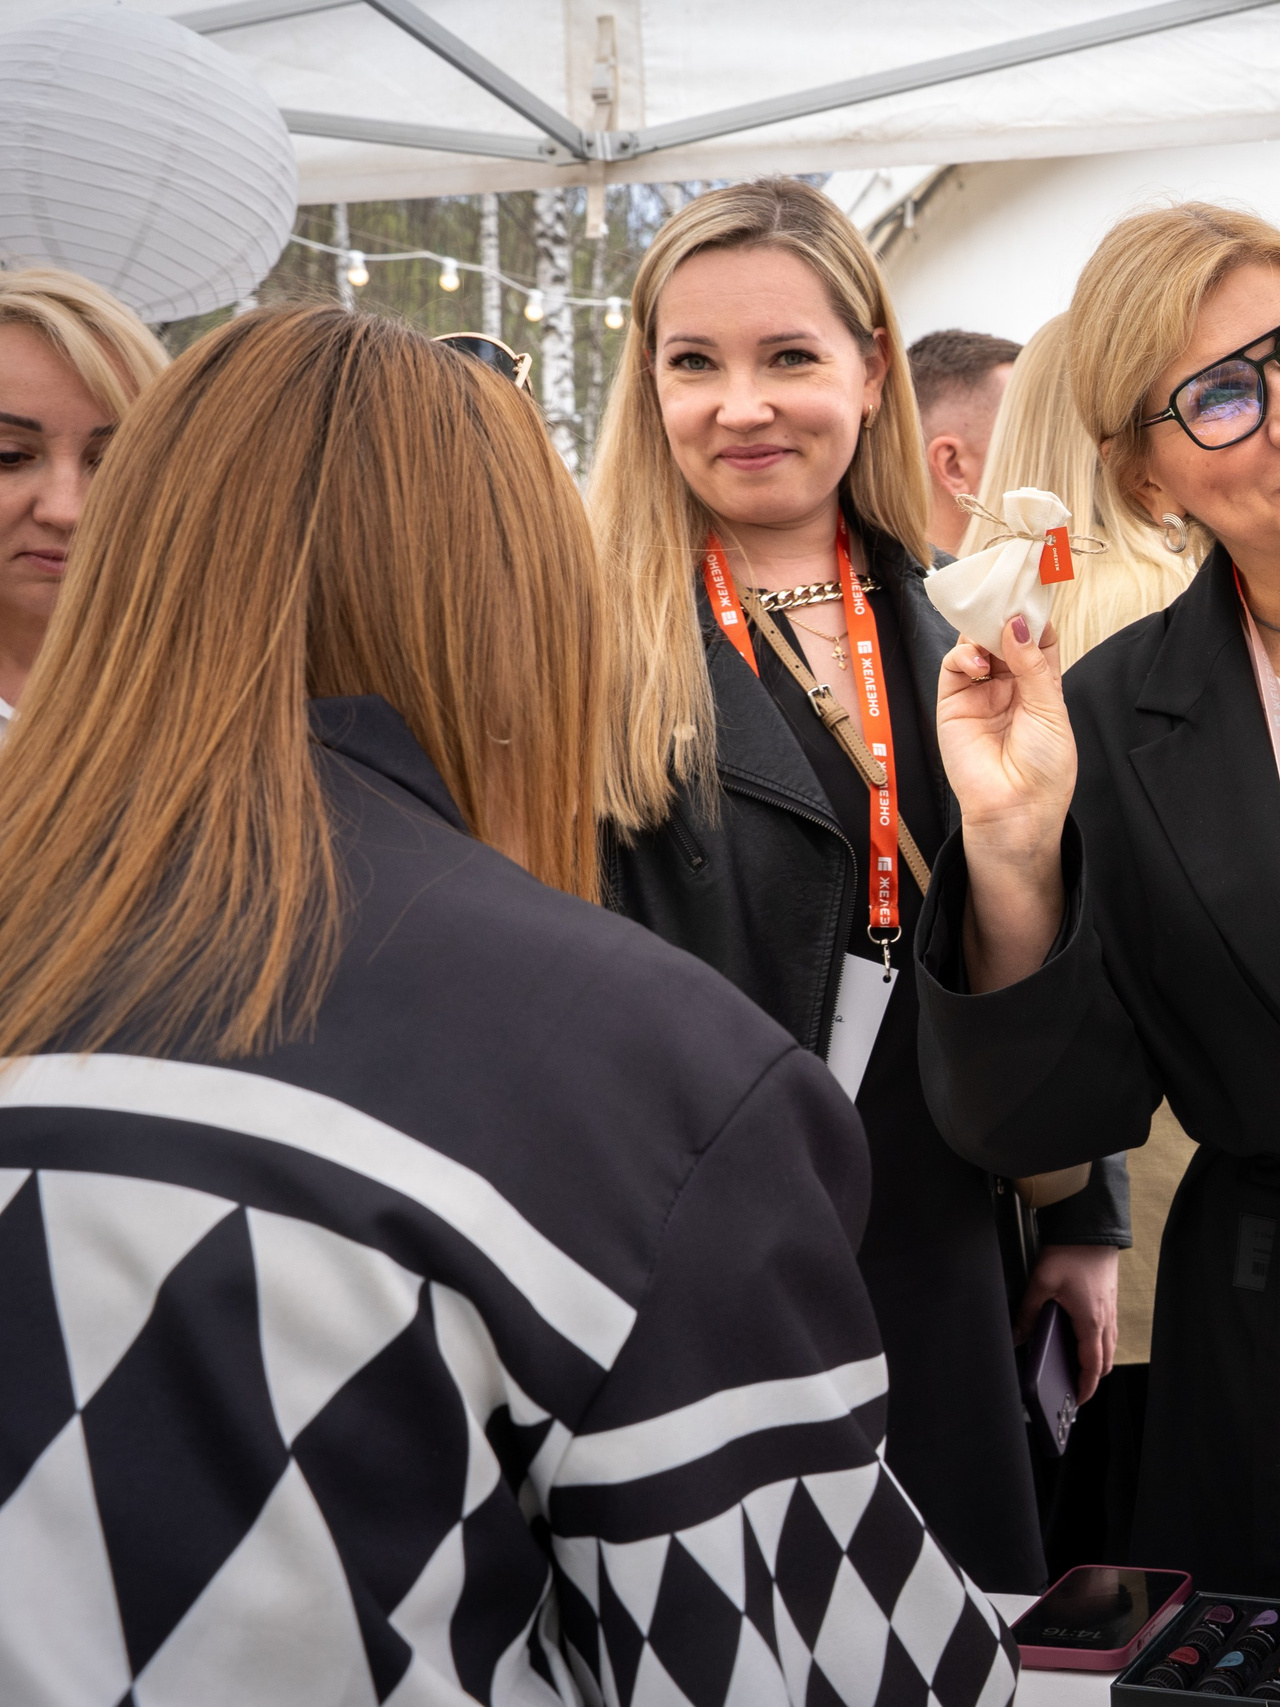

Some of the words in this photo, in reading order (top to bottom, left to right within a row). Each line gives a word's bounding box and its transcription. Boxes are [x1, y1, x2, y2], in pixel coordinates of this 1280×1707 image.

[706, 554, 731, 607] ЖЕЛЕЗНО
[861, 657, 880, 717] ЖЕЛЕЗНО
[879, 876, 891, 928] ЖЕЛЕЗ
[1041, 1627, 1102, 1639] 14:16
